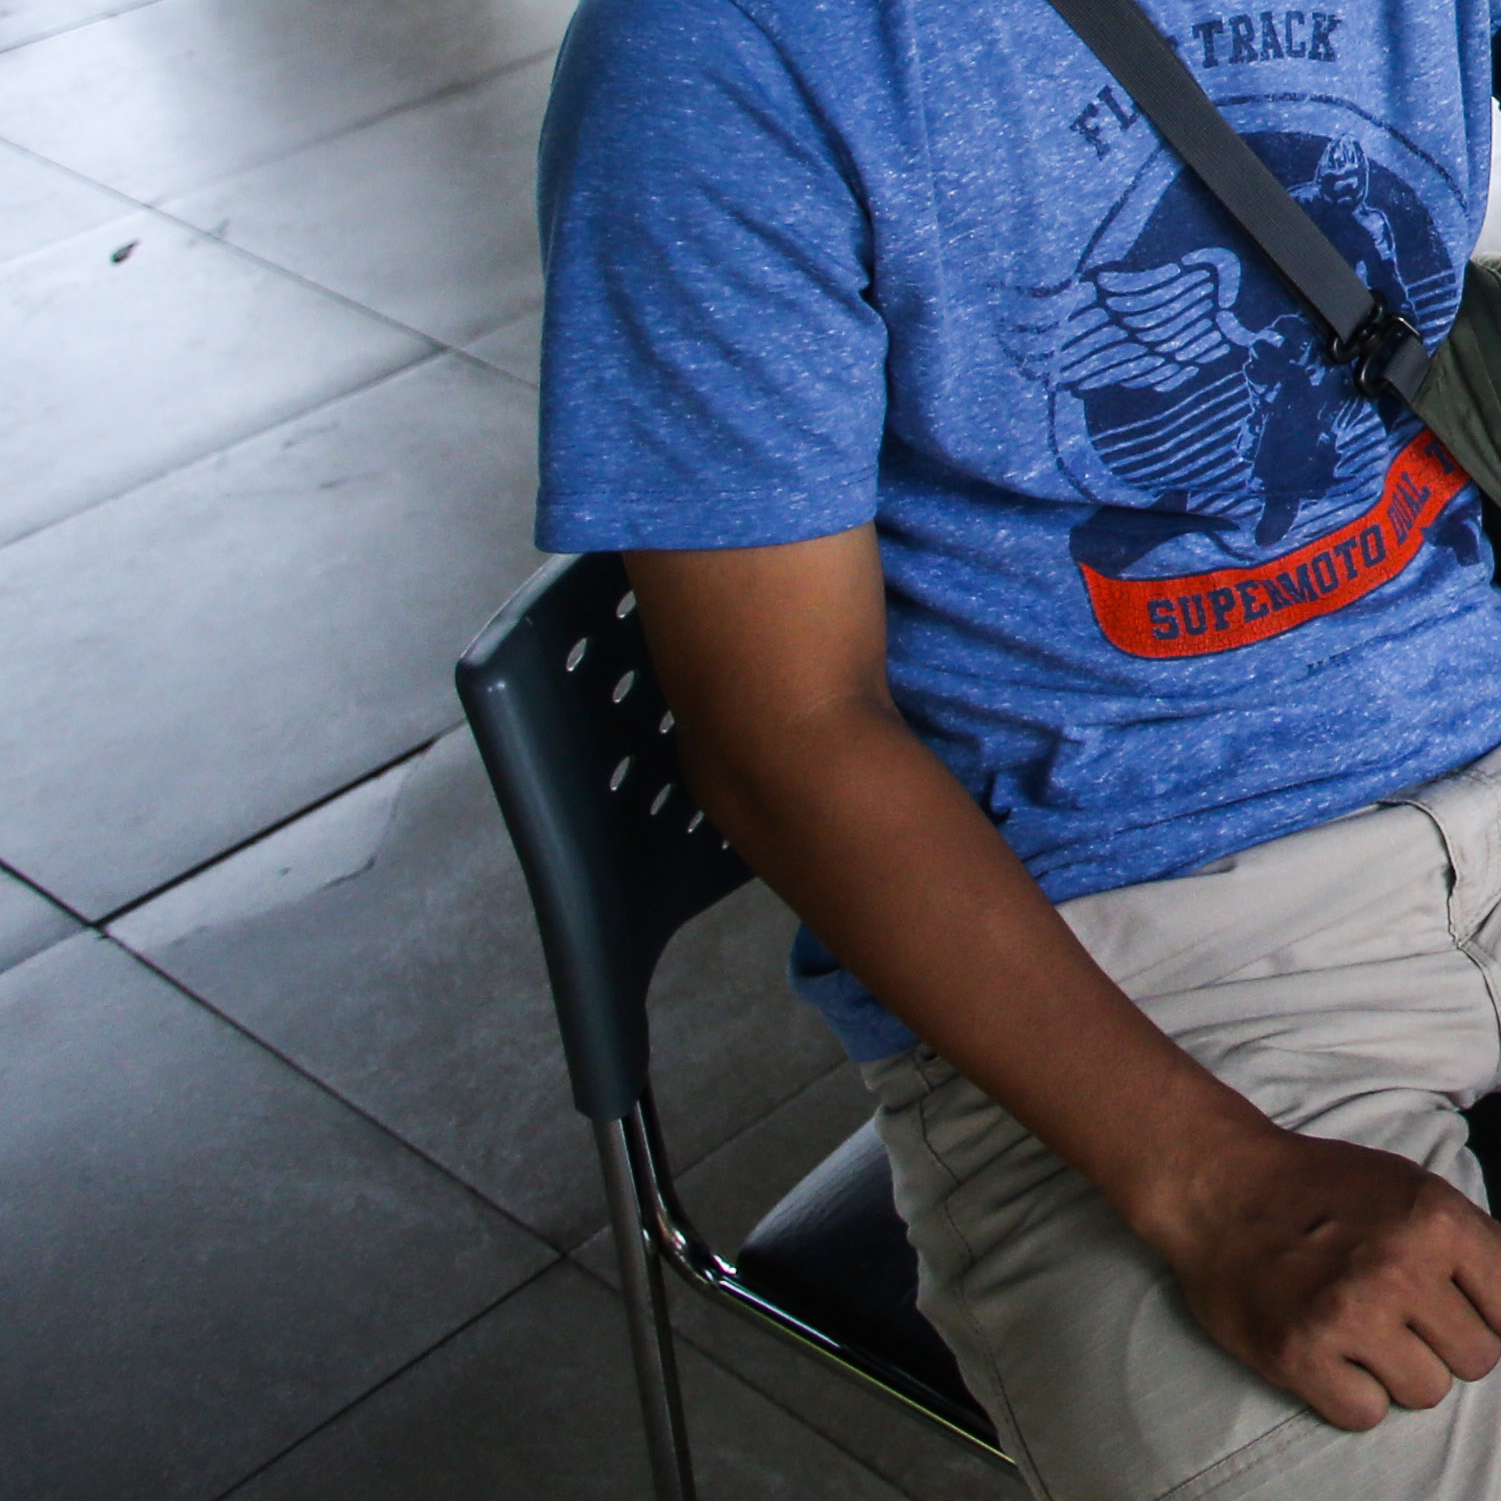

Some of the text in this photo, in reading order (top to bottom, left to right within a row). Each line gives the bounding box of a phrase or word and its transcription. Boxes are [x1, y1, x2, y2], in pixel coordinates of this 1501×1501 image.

[1191, 10, 1341, 68] TRACK
[1147, 524, 1387, 640] SUPERMOTO
[1387, 472, 1431, 546] DUAL
